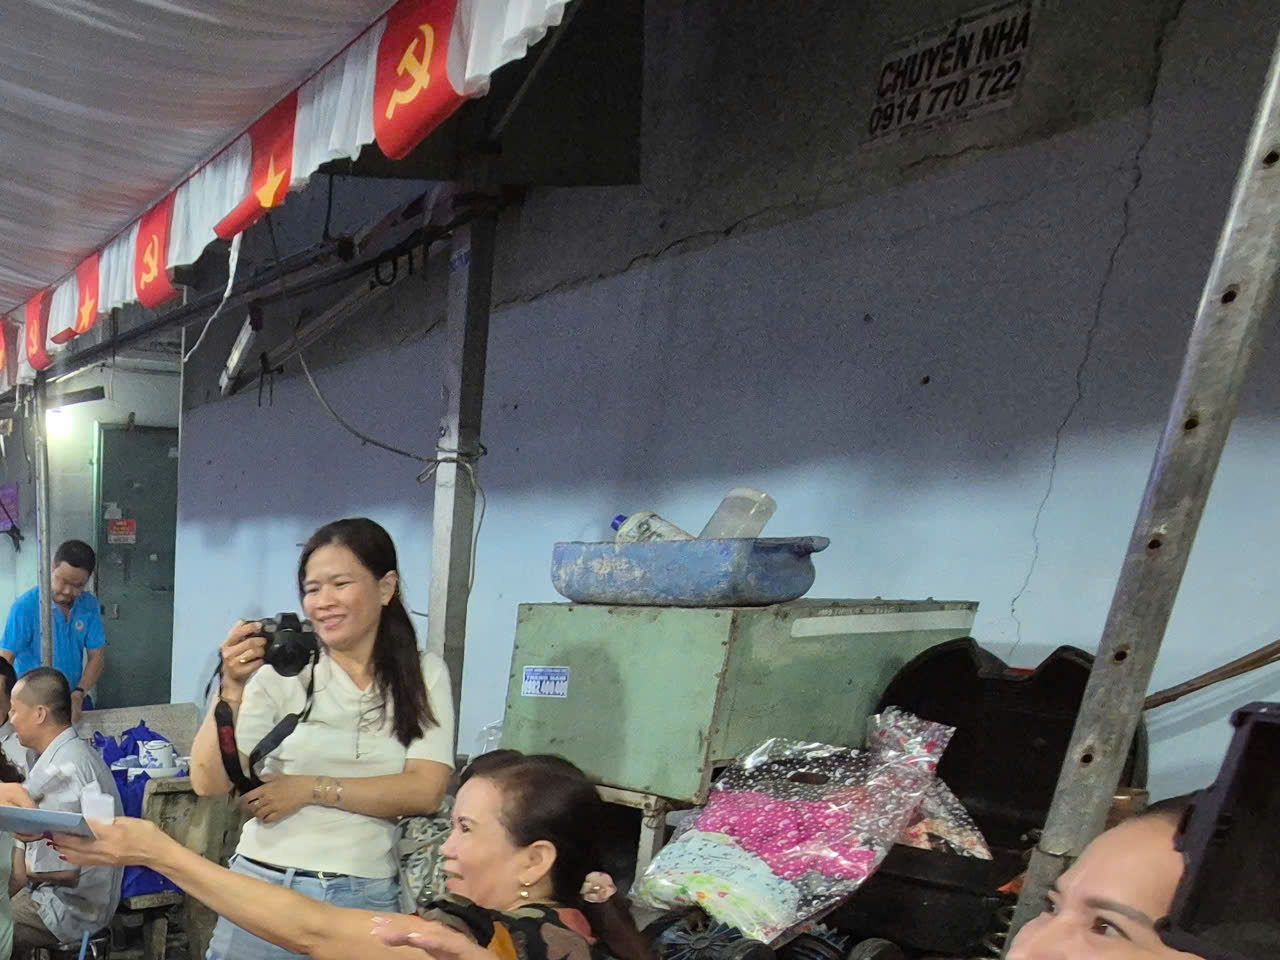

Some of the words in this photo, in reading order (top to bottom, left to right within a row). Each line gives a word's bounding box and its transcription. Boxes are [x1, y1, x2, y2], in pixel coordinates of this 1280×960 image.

[869, 94, 920, 135] 0914
[926, 79, 970, 116] 770
[976, 60, 1021, 100] 722
